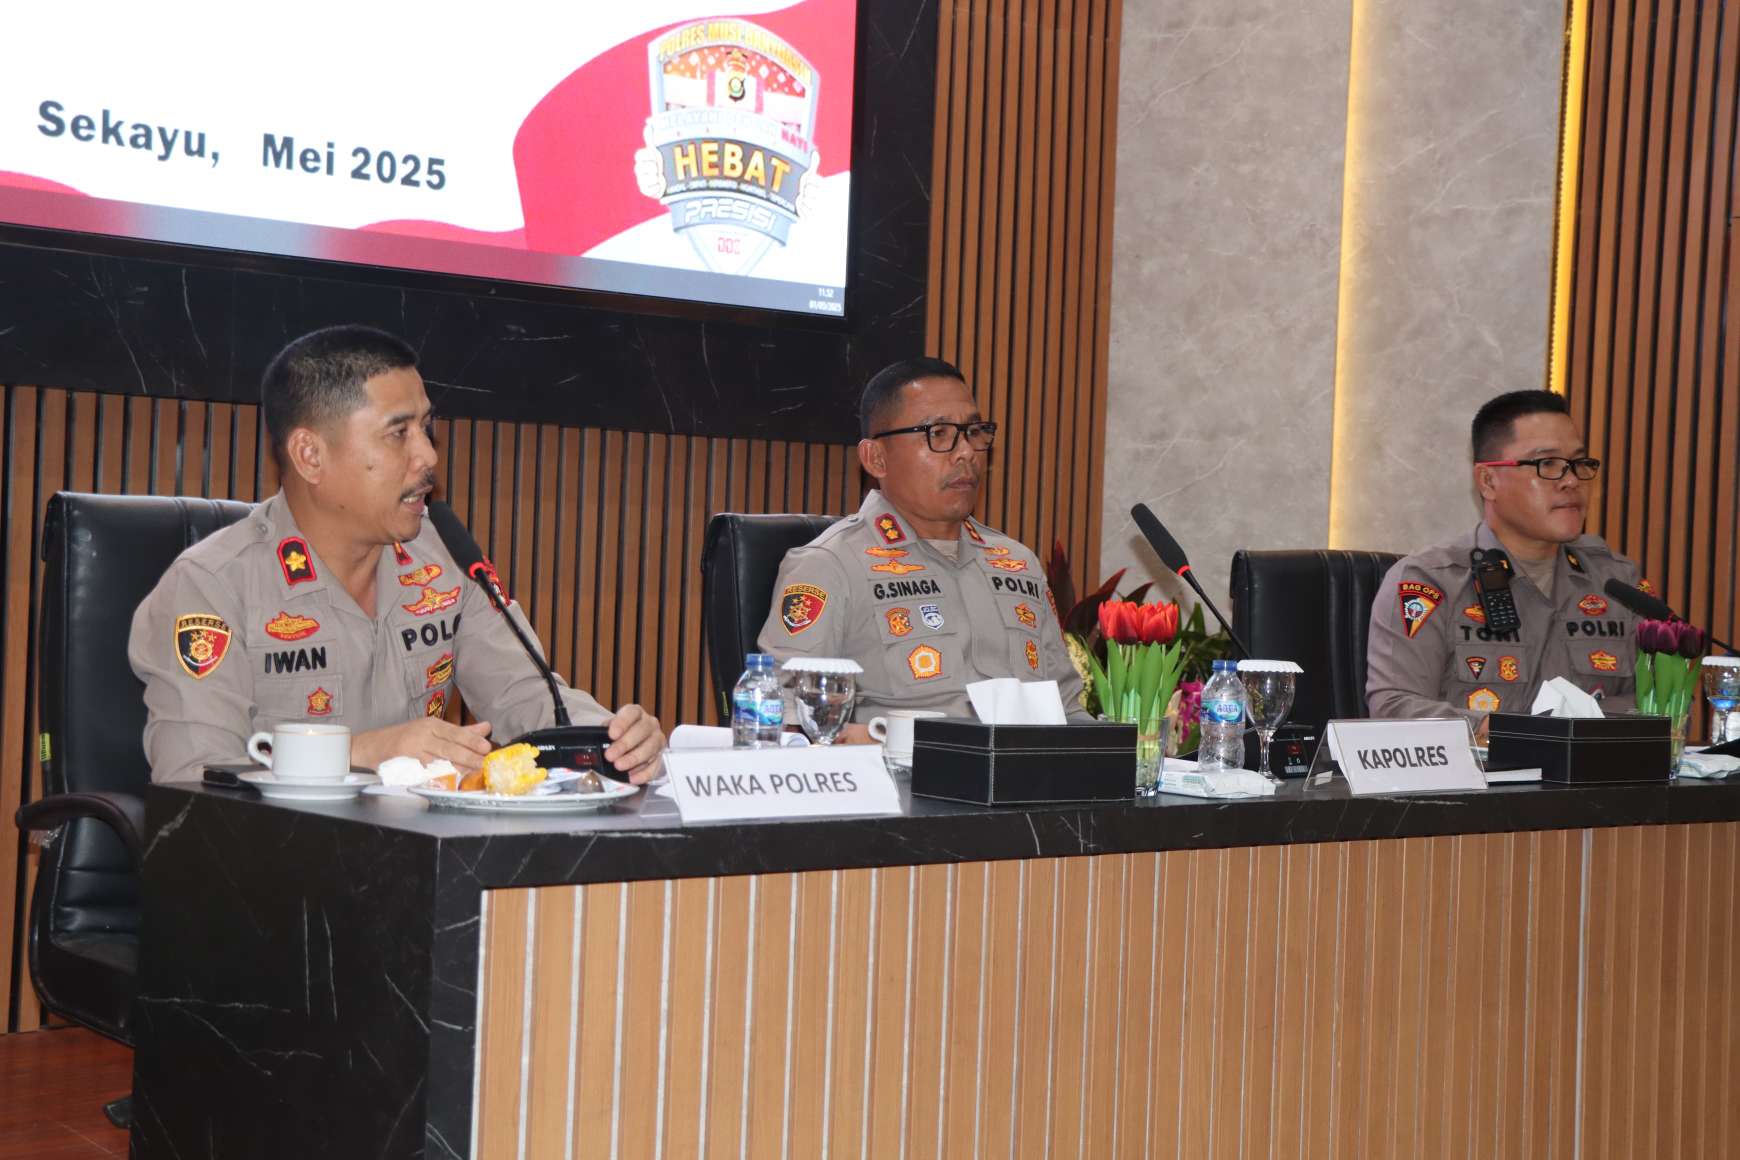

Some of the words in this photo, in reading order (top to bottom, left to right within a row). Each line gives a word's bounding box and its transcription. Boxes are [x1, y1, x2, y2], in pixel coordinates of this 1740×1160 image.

[37, 100, 220, 168] Sekayu,
[261, 133, 335, 176] Mei
[350, 146, 446, 191] 2025
[672, 141, 791, 193] HEBAT
[683, 197, 777, 232] PRESISI
[873, 579, 942, 600] G.SINAGA
[991, 576, 1040, 599] POLRI
[1402, 583, 1421, 591] BAG
[1566, 620, 1624, 637] POLRI
[264, 646, 327, 674] IWAN
[1357, 745, 1449, 770] KAPOLRES
[685, 773, 767, 798] WAKA
[770, 771, 858, 795] POLRES
